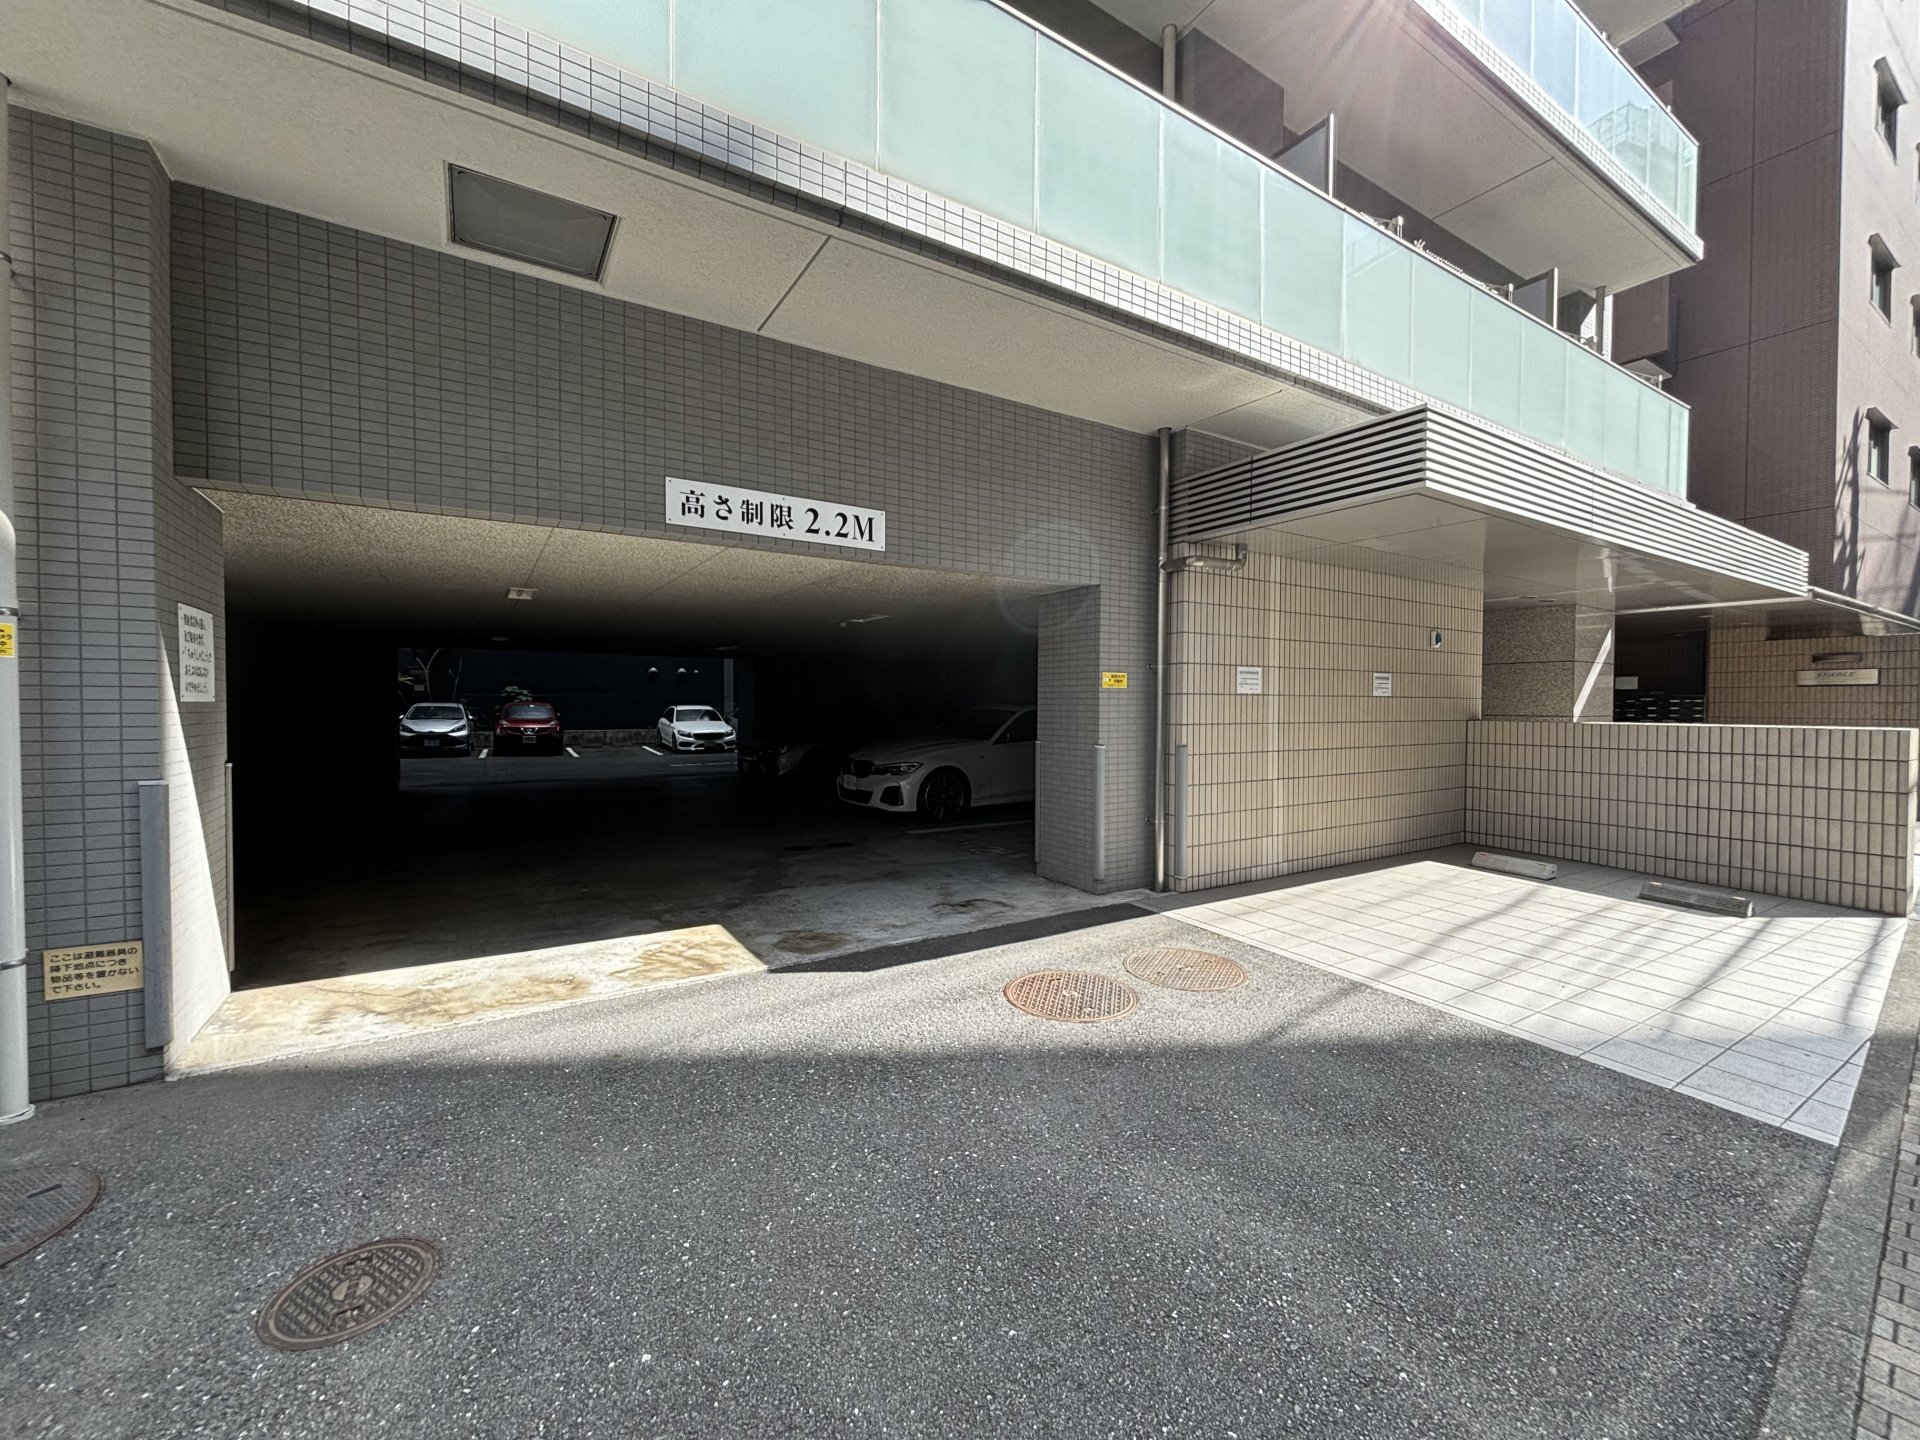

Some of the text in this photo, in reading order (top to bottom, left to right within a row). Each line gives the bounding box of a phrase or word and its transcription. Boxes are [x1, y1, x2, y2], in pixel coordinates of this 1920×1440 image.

[49, 947, 138, 963] ここは避難器具の
[49, 958, 128, 973] 降下地点につき
[50, 967, 139, 984] 物品等を置かない
[51, 981, 102, 994] で下さい。
